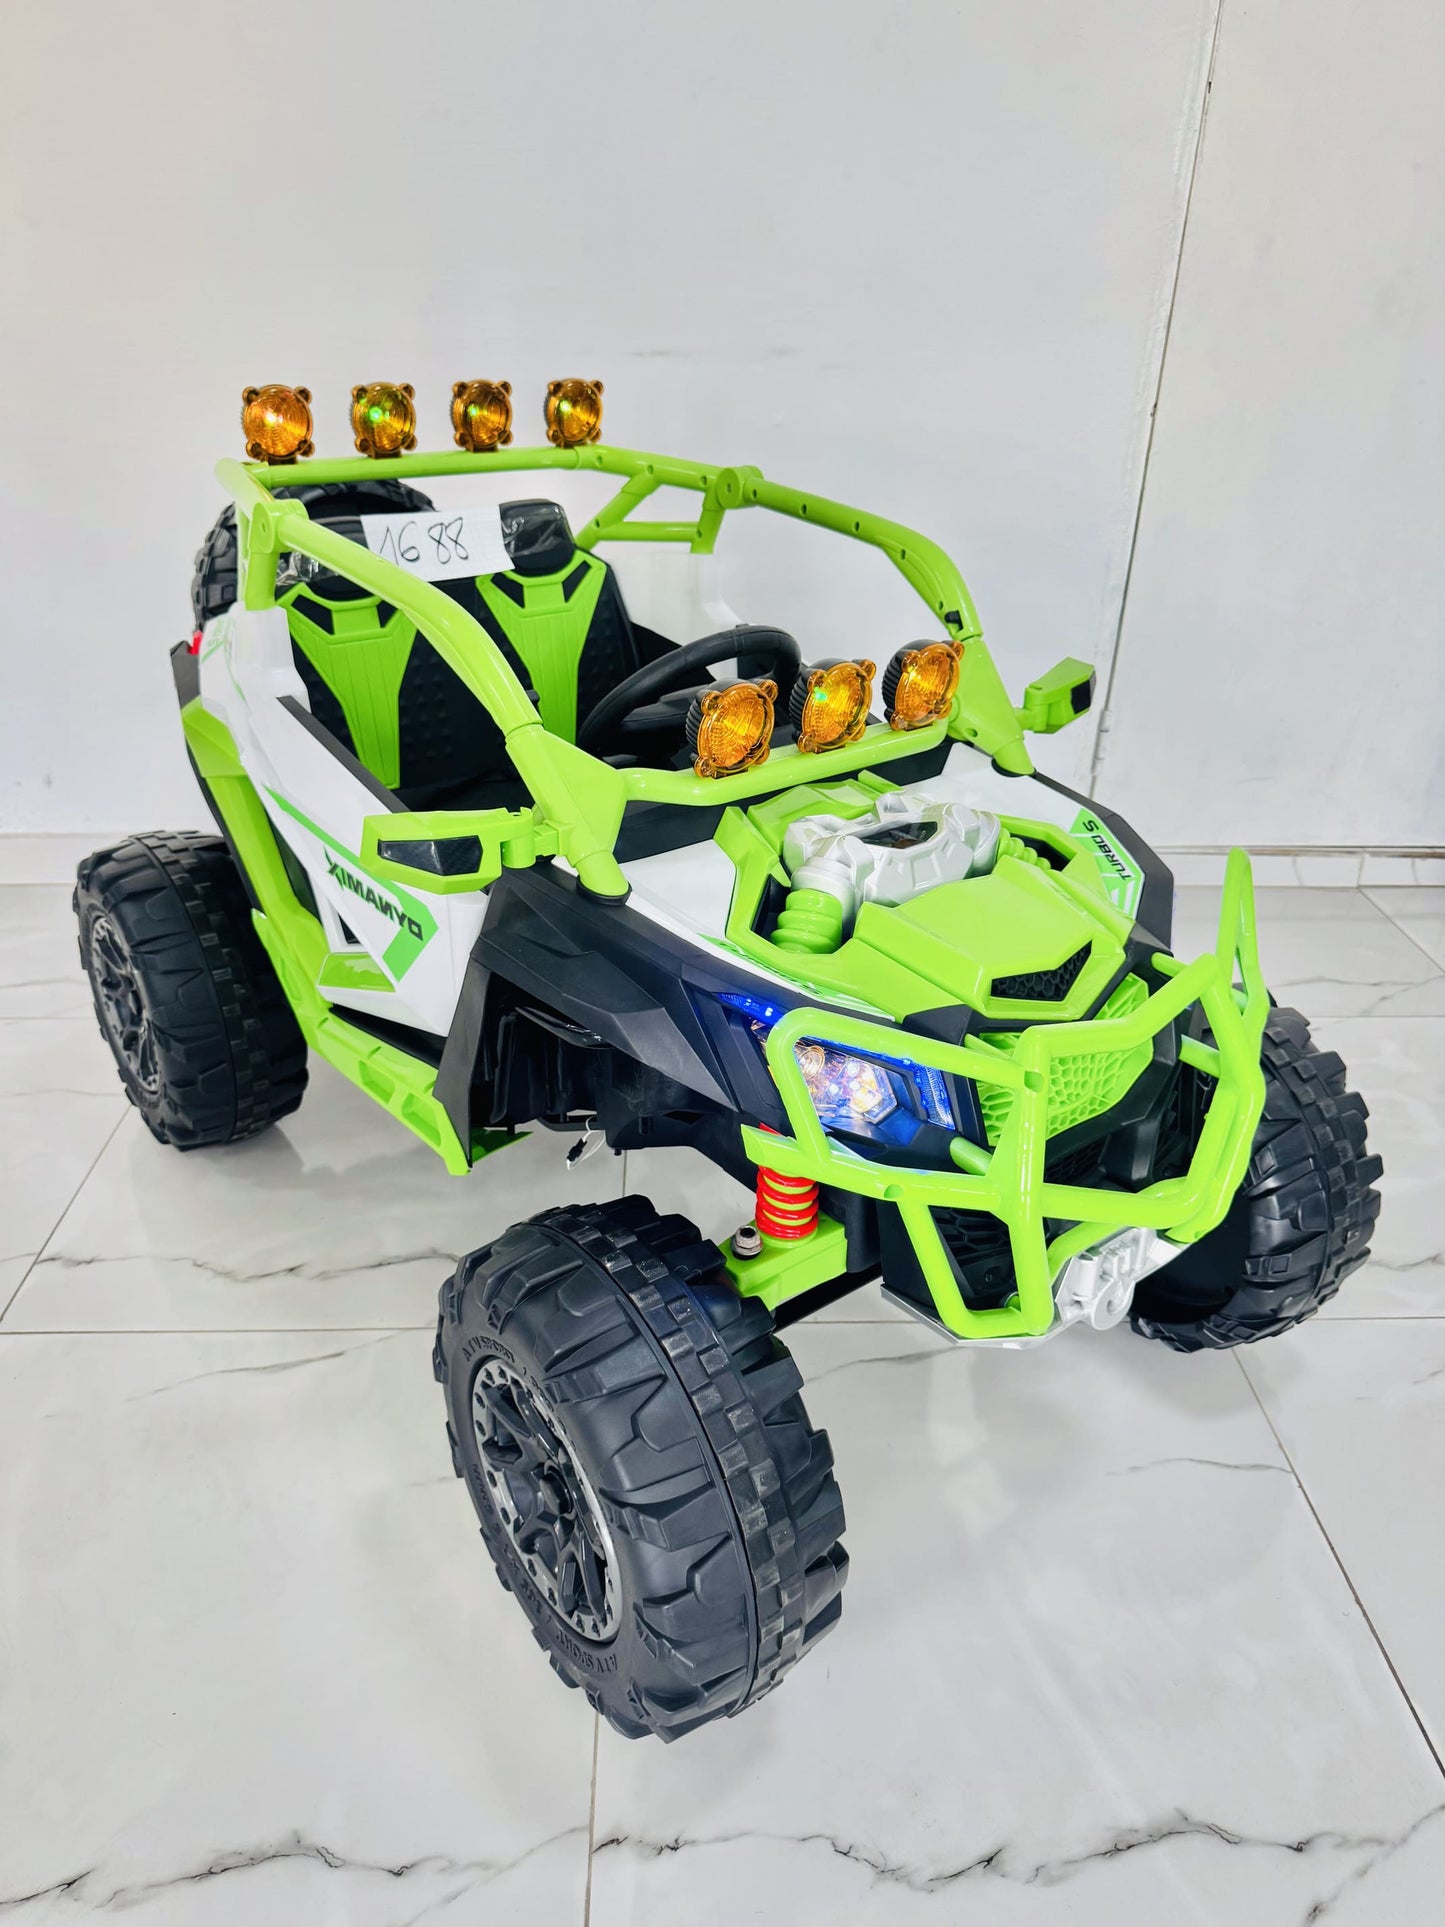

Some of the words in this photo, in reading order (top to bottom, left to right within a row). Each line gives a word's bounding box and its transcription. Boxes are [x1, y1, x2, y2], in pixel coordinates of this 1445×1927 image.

[380, 516, 468, 565] 1688
[1083, 820, 1099, 832] S
[1091, 835, 1131, 880] TURBO
